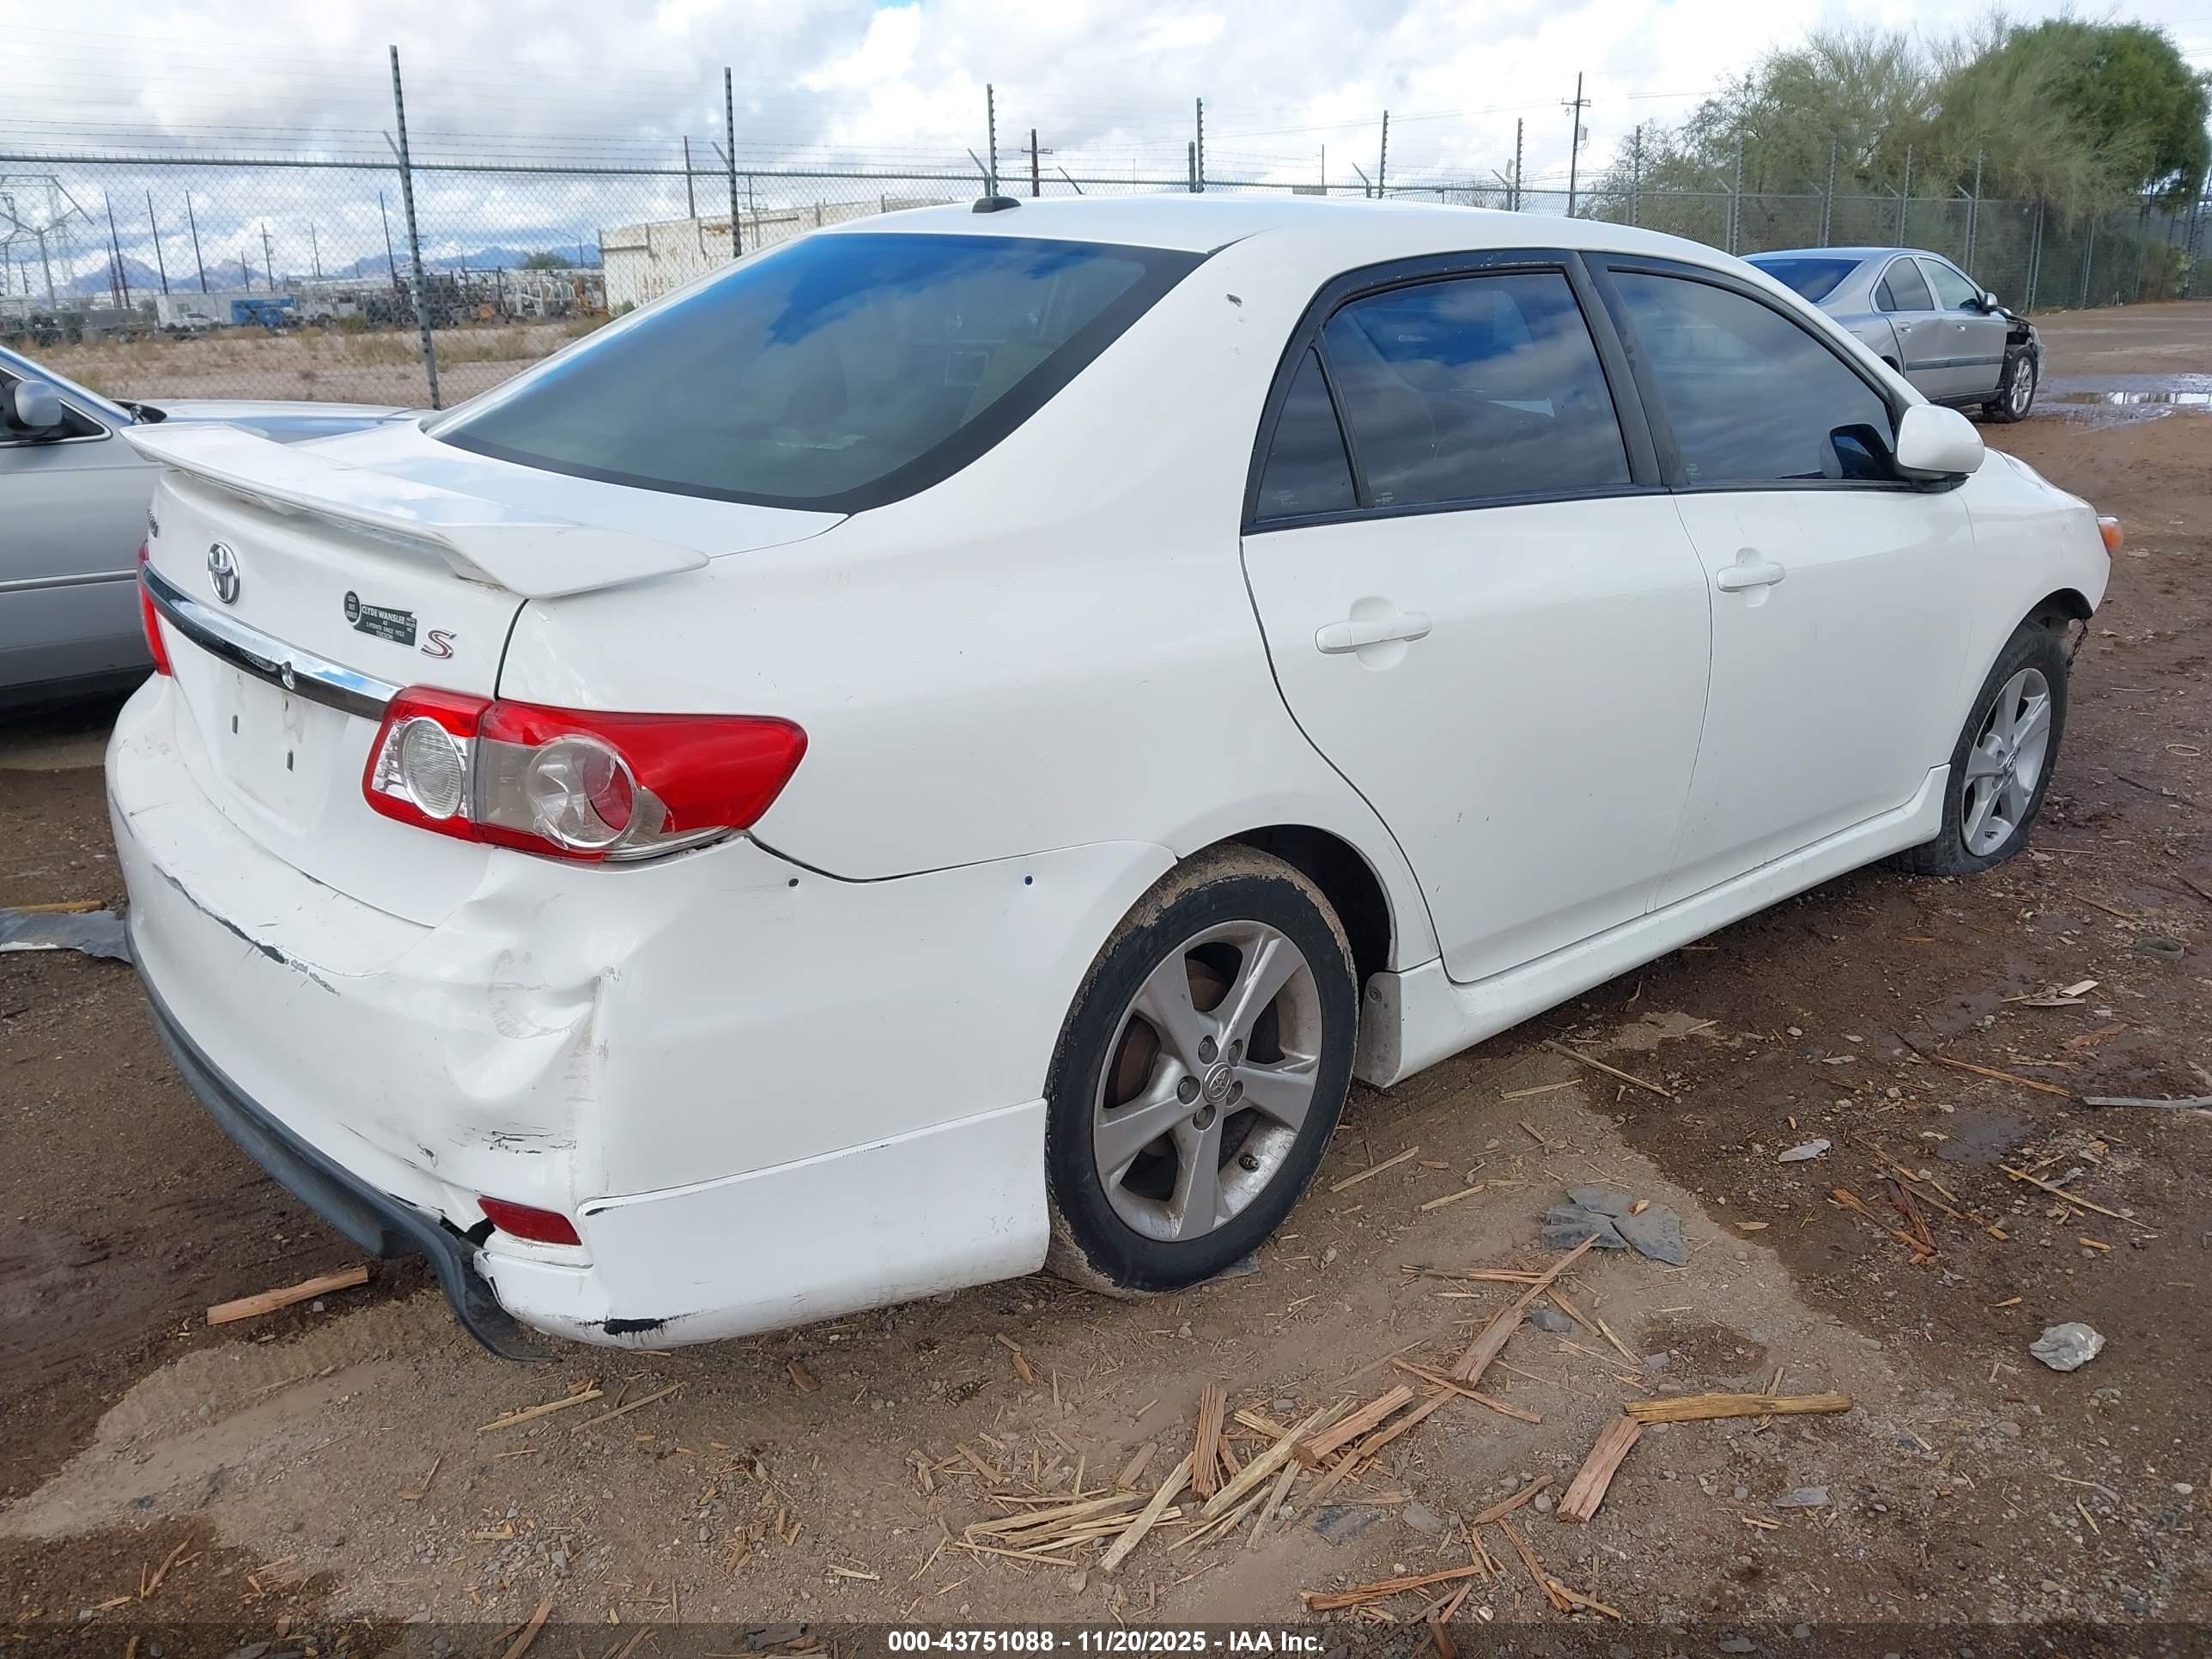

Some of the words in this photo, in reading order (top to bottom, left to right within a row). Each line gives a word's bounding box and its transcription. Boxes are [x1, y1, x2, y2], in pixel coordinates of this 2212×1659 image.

[362, 605, 378, 617] CLYDE
[378, 610, 405, 624] WANSLEE
[376, 629, 393, 640] TUCSON
[420, 628, 457, 659] S
